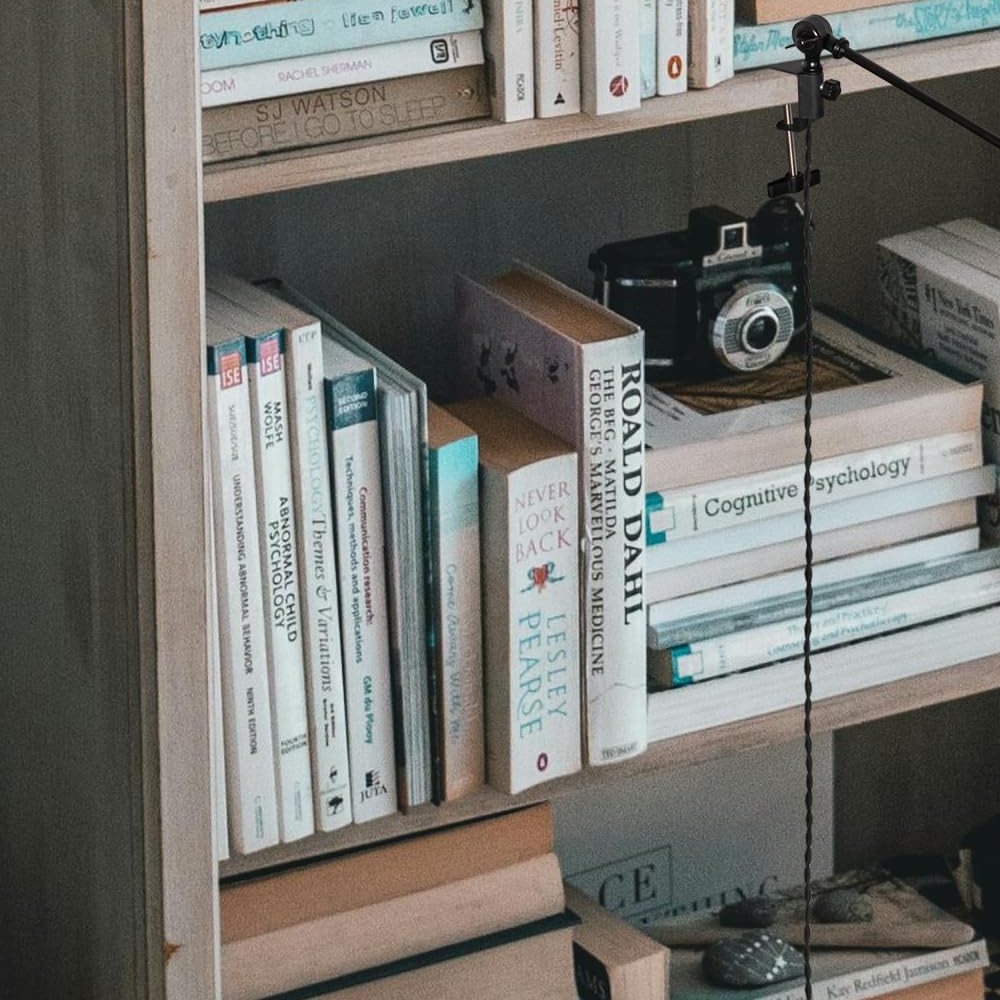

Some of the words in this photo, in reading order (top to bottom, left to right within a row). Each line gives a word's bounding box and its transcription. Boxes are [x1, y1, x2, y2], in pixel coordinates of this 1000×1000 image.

[278, 67, 318, 83] RACHEL
[322, 58, 374, 77] SHERMAN
[554, 27, 565, 71] Levitin
[202, 117, 290, 155] BEFORE
[304, 113, 341, 138] GO
[348, 109, 375, 130] TO
[381, 95, 446, 125] SLEEP
[256, 102, 283, 123] SJ
[292, 86, 387, 115] WATSON
[222, 369, 242, 387] ISE
[261, 356, 281, 374] ISE
[603, 365, 615, 402] THE
[264, 401, 275, 450] WOLFE
[273, 401, 284, 443] MASH
[589, 369, 602, 456] GEORGE'S
[603, 408, 616, 441] BFG
[621, 360, 642, 497] ROALD
[344, 456, 356, 521] Techniques,
[515, 481, 571, 513] NEVER
[604, 459, 617, 540] MATILDA
[704, 483, 800, 517] Cognitive
[232, 473, 246, 560] UNDERSTANDING
[358, 486, 371, 575] Communication
[519, 504, 566, 535] LOOK
[589, 462, 604, 582] MARVELLOUS
[279, 496, 295, 590] ABNORMAL
[311, 514, 327, 580] Themes
[348, 522, 359, 570] methods
[515, 527, 571, 563] BACK
[238, 563, 250, 623] ABNORMAL
[268, 520, 286, 628] PSYCHOLOGY
[351, 573, 361, 594] and
[623, 512, 643, 626] DAHL
[284, 592, 298, 643] CHILD
[362, 576, 375, 626] research:
[242, 624, 254, 676] BEHAVIOR
[318, 607, 334, 693] Variations
[350, 598, 364, 664] applications
[591, 587, 604, 677] MEDICINE
[517, 610, 543, 739] PEARSE
[546, 614, 568, 717] LESLEY
[246, 687, 255, 716] NINTH
[247, 718, 258, 756] EDITION
[360, 784, 388, 804] JUTA
[826, 985, 851, 1000] Kay
[853, 969, 902, 994] Redfield
[903, 959, 951, 983] Jamison
